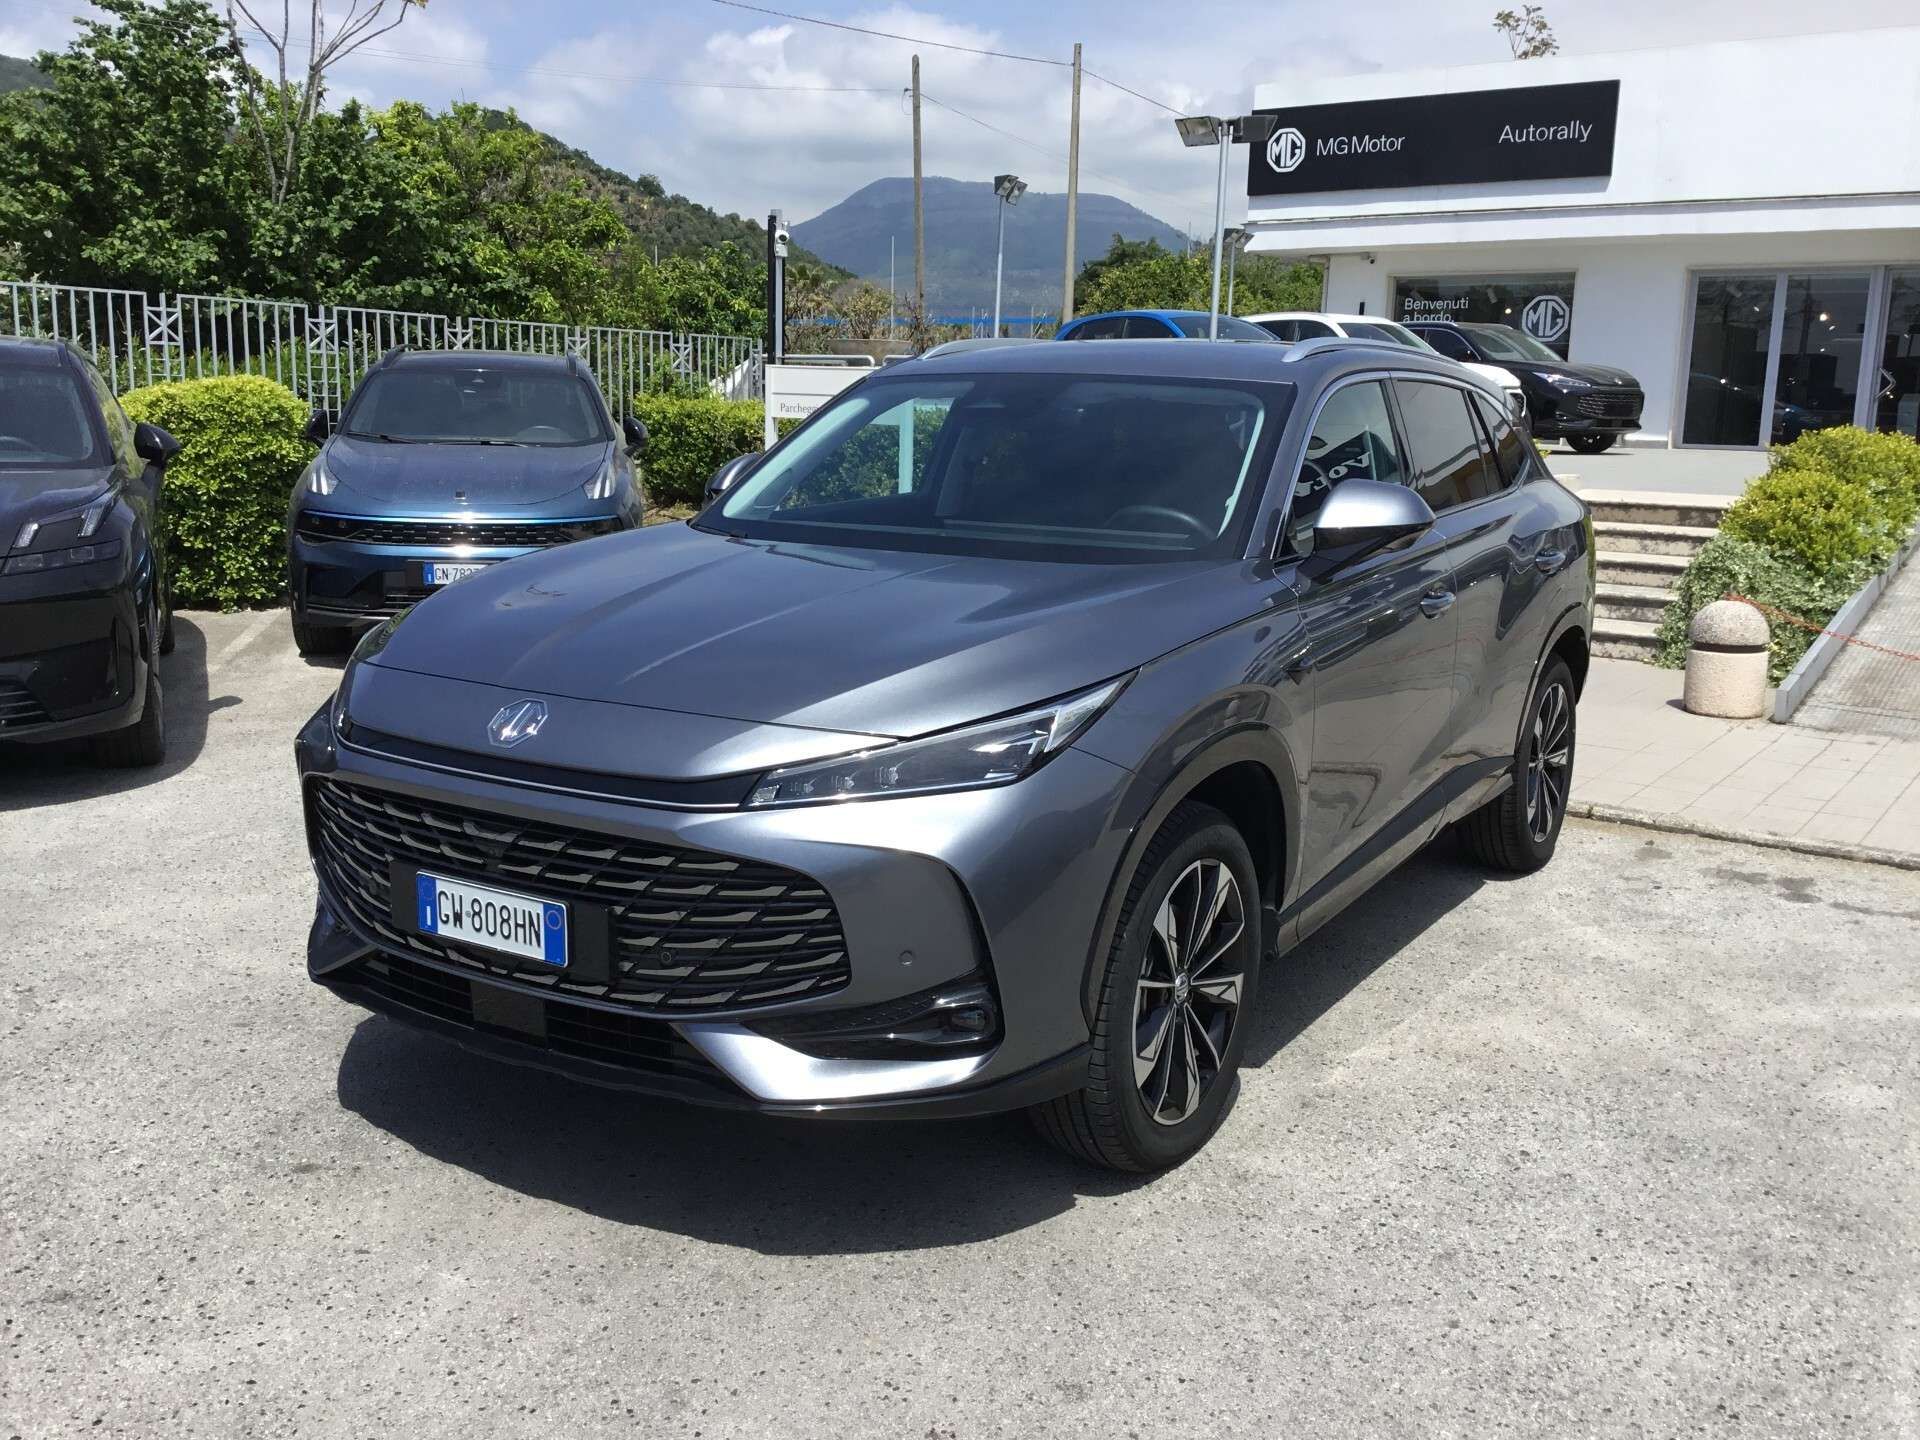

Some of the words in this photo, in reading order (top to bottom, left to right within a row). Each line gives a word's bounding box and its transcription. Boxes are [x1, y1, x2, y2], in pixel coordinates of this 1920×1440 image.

[1498, 120, 1593, 144] Autorally
[1316, 137, 1348, 156] MG
[1351, 134, 1406, 154] Motor
[1404, 297, 1469, 311] Benvenuti
